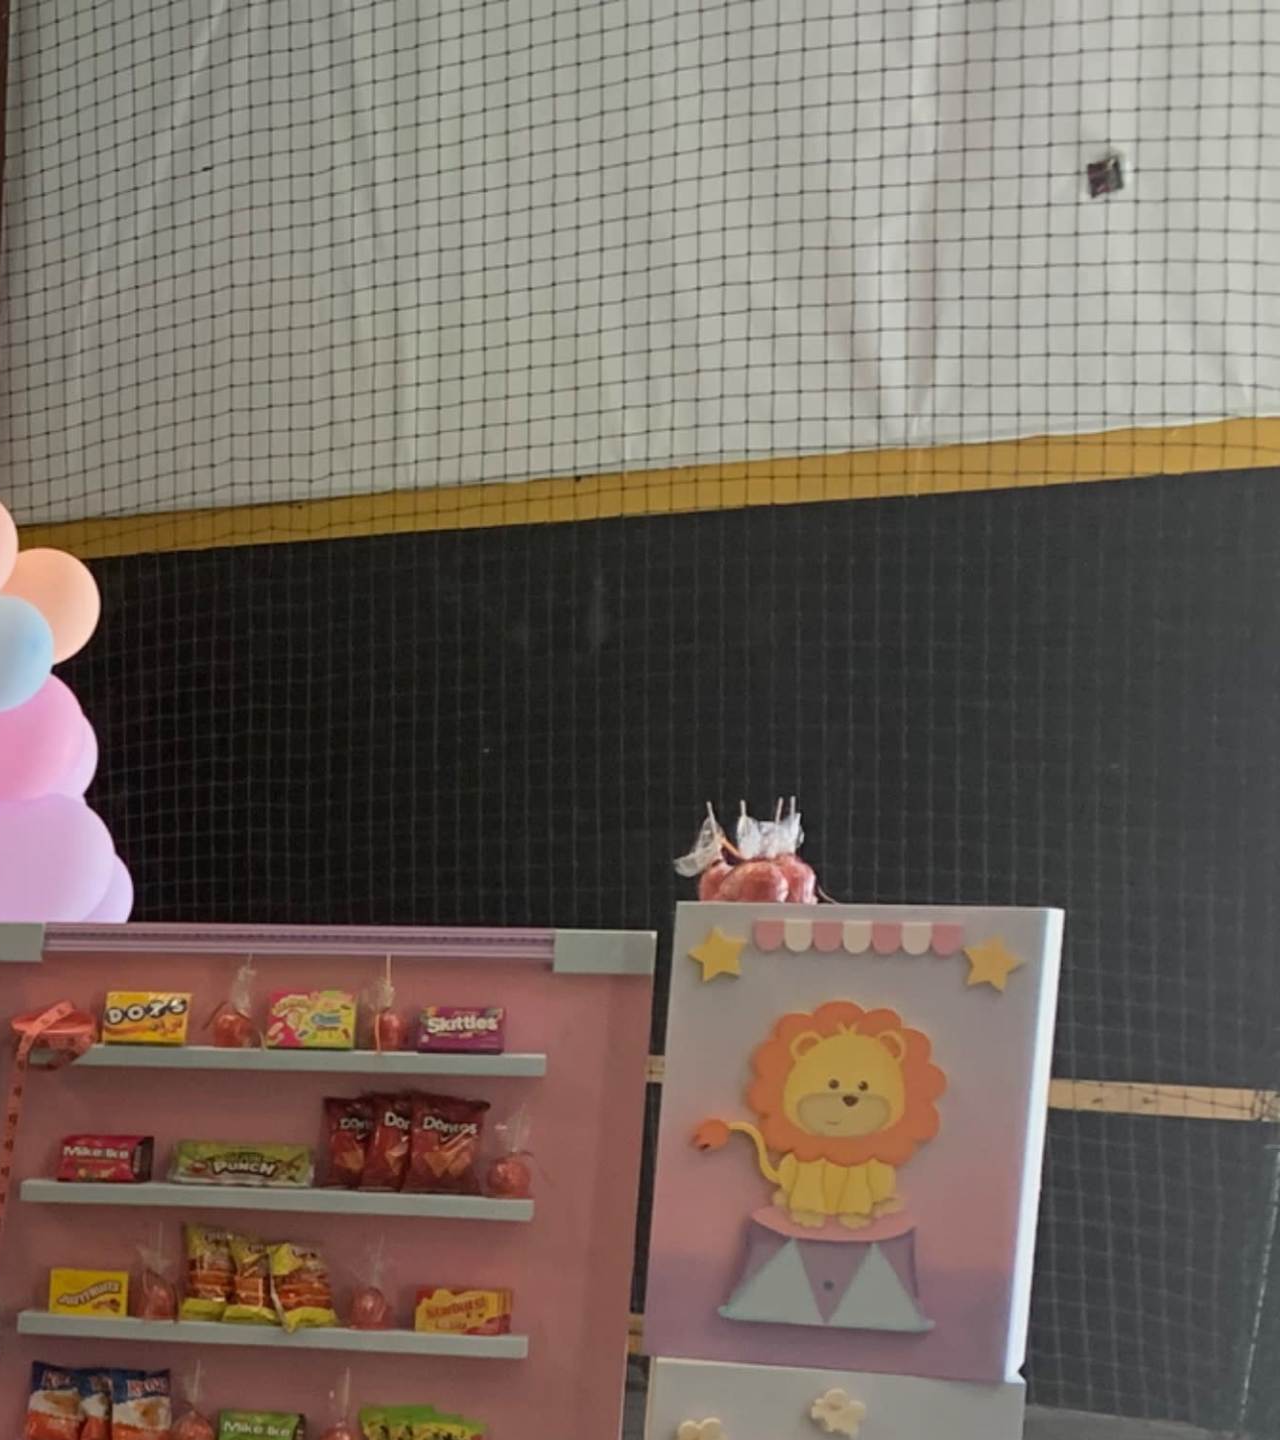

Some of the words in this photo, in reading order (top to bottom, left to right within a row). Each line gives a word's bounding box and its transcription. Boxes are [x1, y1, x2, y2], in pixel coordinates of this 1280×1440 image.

[104, 998, 187, 1025] DOTS
[427, 1015, 498, 1033] Skittles
[423, 1116, 478, 1135] Doritos
[63, 1146, 102, 1157] Mike
[213, 1159, 275, 1175] PUNCH
[224, 1421, 262, 1434] Mike
